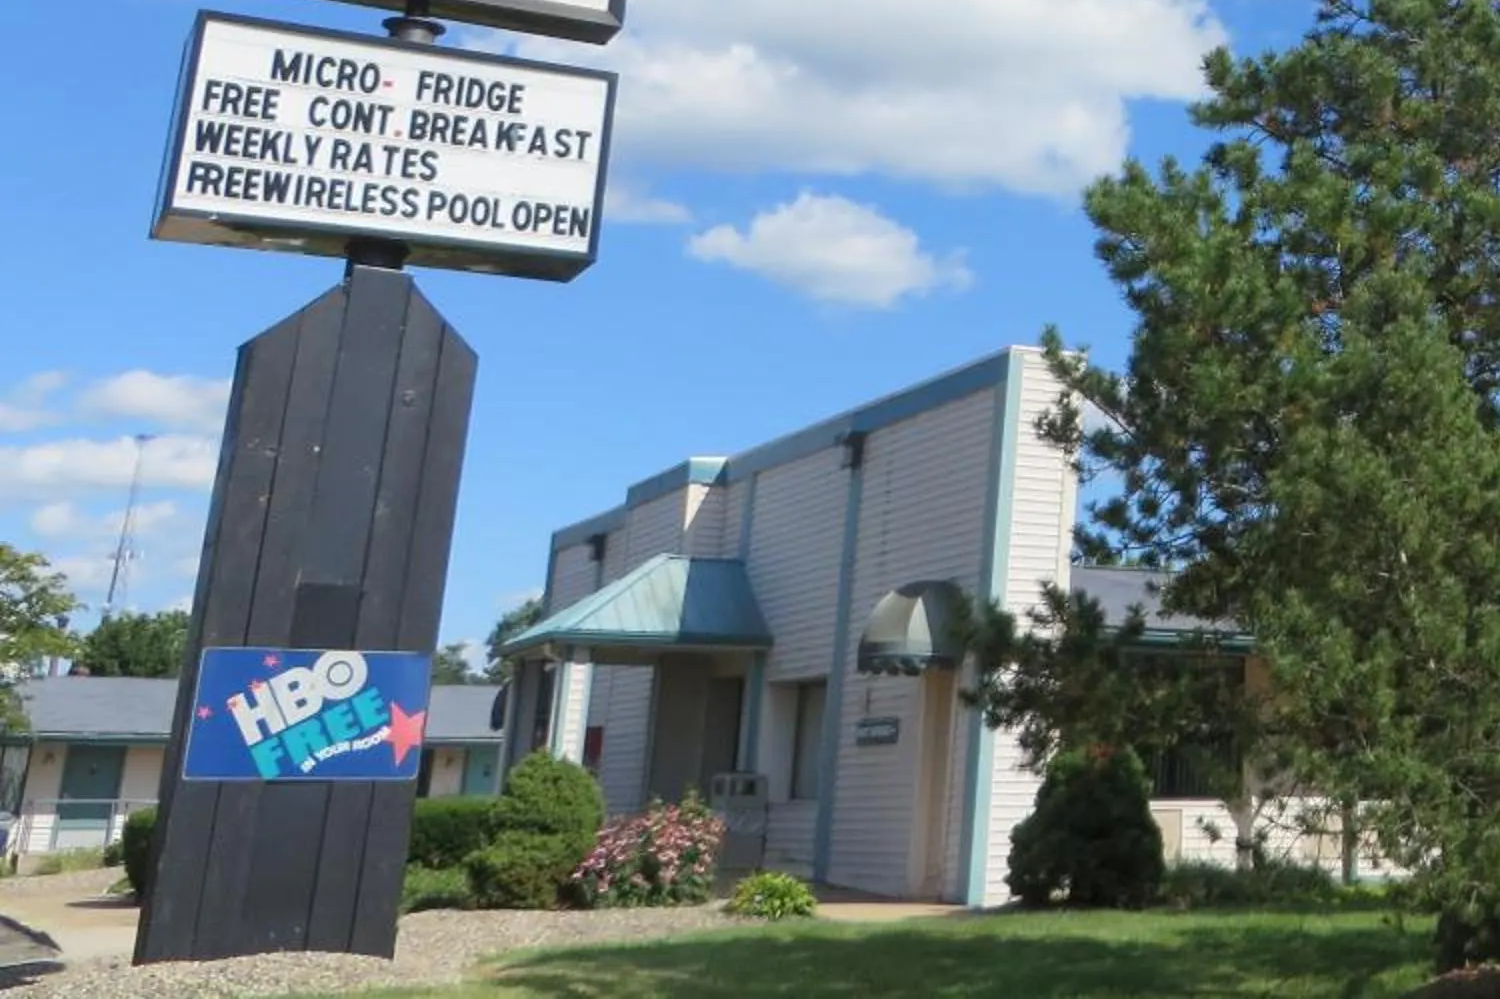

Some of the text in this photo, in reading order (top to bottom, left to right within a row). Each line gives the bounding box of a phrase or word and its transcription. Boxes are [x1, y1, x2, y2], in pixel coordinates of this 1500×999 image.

[202, 80, 279, 121] FREE
[409, 110, 592, 161] BREAKFAST
[416, 70, 526, 115] FRIDGE
[194, 120, 439, 182] WEEKLY RATES
[426, 191, 505, 230] POOL
[511, 199, 590, 238] OPEN
[226, 650, 368, 747] HBO
[250, 686, 389, 781] FREE
